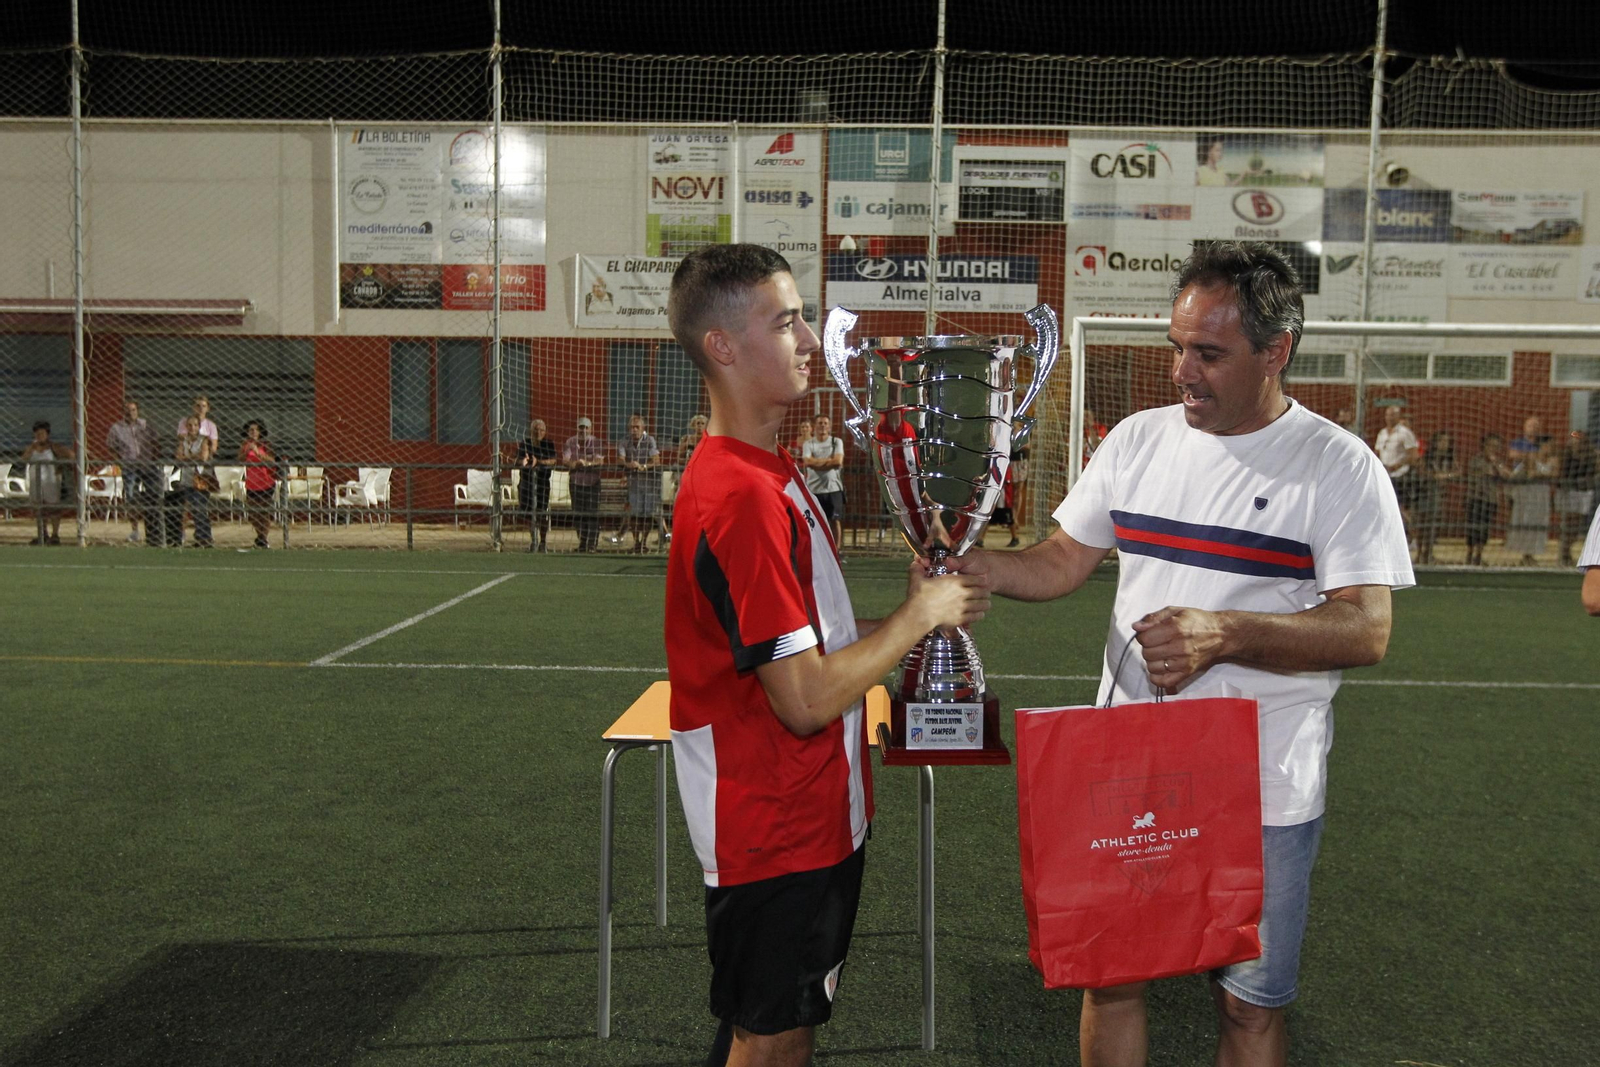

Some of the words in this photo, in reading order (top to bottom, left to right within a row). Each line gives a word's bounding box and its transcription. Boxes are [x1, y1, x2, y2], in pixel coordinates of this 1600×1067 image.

[366, 131, 379, 143] LA
[686, 135, 729, 143] ORTEGA
[754, 159, 806, 167] AGROTECNO
[1091, 153, 1156, 179] CASI
[652, 176, 724, 200] NOVI
[962, 188, 991, 196] LOCAL
[606, 260, 621, 273] EL
[903, 260, 1010, 279] HYUNDAI
[881, 285, 983, 302] Almeialva
[616, 306, 655, 318] Jugamos
[931, 727, 957, 736] CAMPEÓN
[1090, 832, 1157, 850] ATHLETIC
[1161, 828, 1200, 841] CLUB
